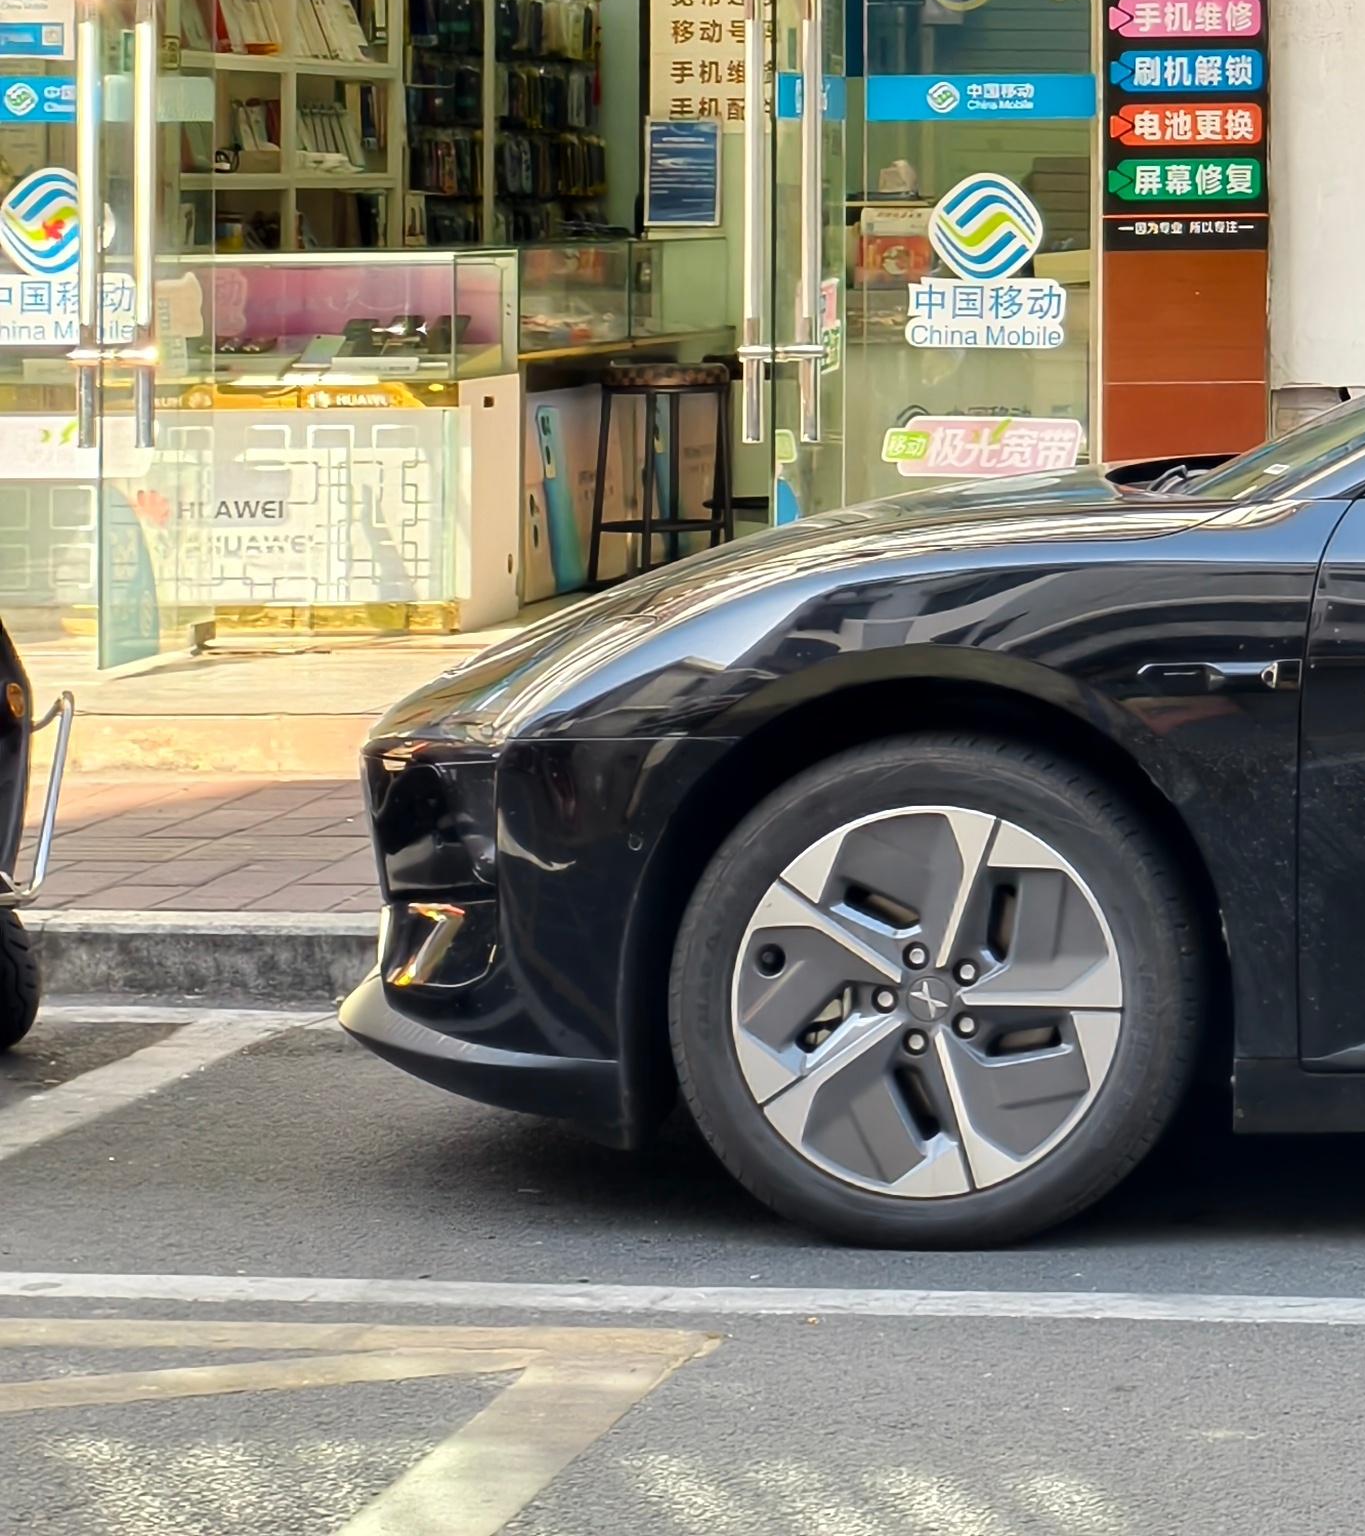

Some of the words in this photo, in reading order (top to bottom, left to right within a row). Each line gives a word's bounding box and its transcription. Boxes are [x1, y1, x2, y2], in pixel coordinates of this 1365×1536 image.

[1133, 1, 1253, 32] 手机维修
[1132, 55, 1253, 87] 刷机解锁
[966, 83, 1035, 99] 中国移动
[1133, 110, 1254, 141] 电池更换
[1133, 164, 1254, 196] 屏幕修复
[914, 284, 1062, 321] 中国移动
[910, 324, 979, 347] China
[985, 324, 1061, 347] Mobile
[888, 434, 928, 457] 移动
[928, 425, 1077, 468] 极光宽带
